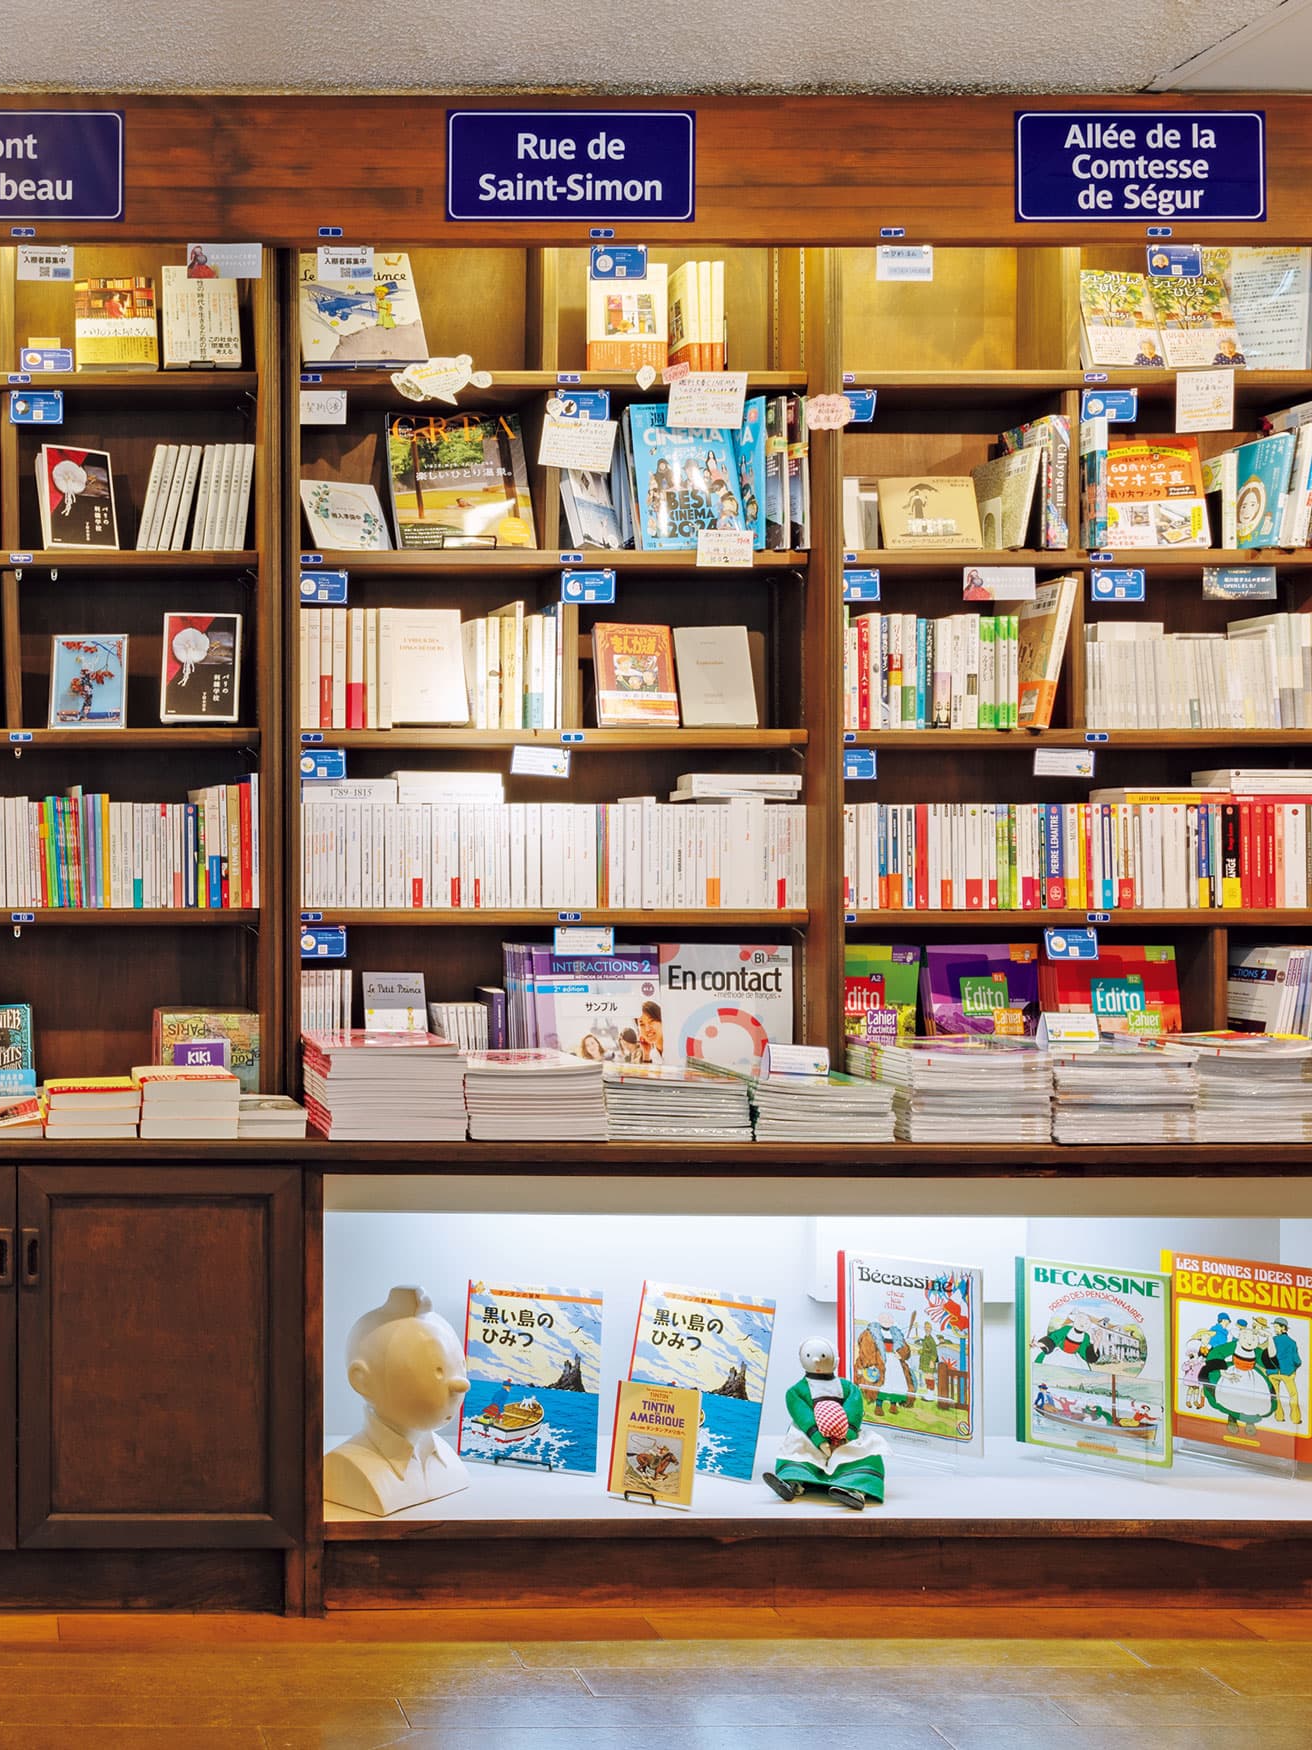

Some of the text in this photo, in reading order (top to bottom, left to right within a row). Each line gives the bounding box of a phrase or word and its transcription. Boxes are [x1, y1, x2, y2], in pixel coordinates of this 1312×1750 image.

[517, 131, 626, 160] Rue de
[1064, 123, 1216, 149] Allée de la
[1072, 155, 1209, 179] Comtesse
[478, 172, 663, 202] Saint-Simon
[1077, 184, 1204, 215] de Ségur
[392, 415, 517, 443] CREA
[643, 427, 724, 446] CINEMA
[666, 489, 712, 511] BEST
[552, 960, 651, 974] INTERACTIONS 2
[668, 965, 783, 992] En contact
[367, 983, 422, 994] Le Petit Prince
[845, 984, 880, 1011] dito
[964, 981, 1005, 1012] Édito
[1096, 982, 1141, 1013] Édito
[585, 1001, 618, 1012] サンプル
[867, 1010, 897, 1026] Cahier
[993, 1010, 1022, 1026] Cahier
[168, 1023, 206, 1036] PARIS
[1128, 1011, 1160, 1027] Cahier
[187, 1050, 211, 1064] KIKI
[858, 1266, 953, 1293] Bécassine
[1176, 1258, 1199, 1271] LES
[1202, 1261, 1251, 1279] BONNES
[1254, 1268, 1292, 1285] IDEES
[482, 1306, 554, 1329] 黒い島の
[653, 1308, 724, 1335] 黒い島の
[482, 1328, 534, 1347] ひみつ
[651, 1329, 702, 1352] ひみつ
[642, 1400, 675, 1414] TINTIN
